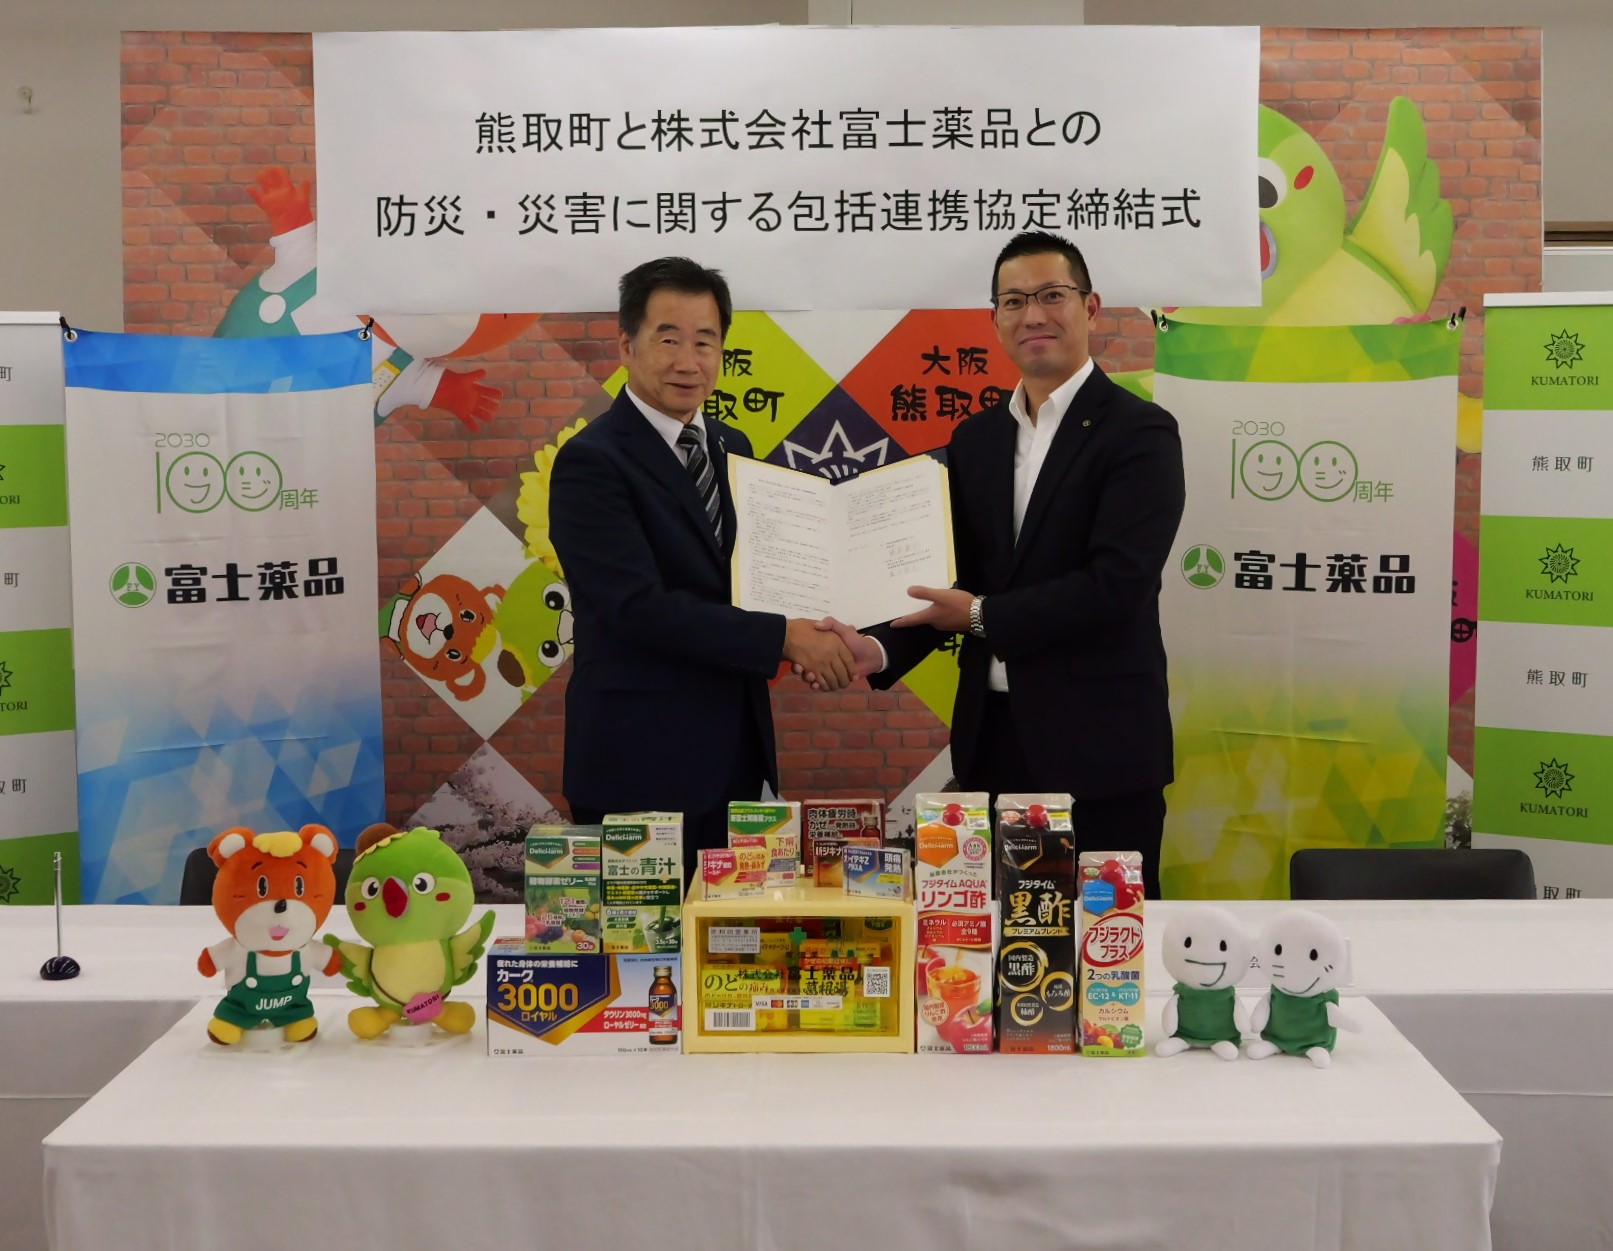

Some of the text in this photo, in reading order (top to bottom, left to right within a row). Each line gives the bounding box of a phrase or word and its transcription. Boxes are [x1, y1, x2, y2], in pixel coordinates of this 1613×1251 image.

[474, 107, 1101, 153] 熊取町と株式会社富士薬品との
[375, 187, 1202, 237] 防災・災害に関する包括連携協定締結式
[921, 345, 988, 375] 大阪
[1531, 376, 1599, 386] KUMATORI
[1232, 420, 1285, 436] 2030
[155, 433, 210, 448] 2030
[1532, 455, 1593, 472] 熊取町
[1234, 550, 1415, 593] 富士薬品
[165, 557, 344, 604] 富士薬品
[1525, 588, 1594, 602] KUMATORI
[1526, 668, 1588, 688] 熊取町
[1520, 802, 1588, 818] KUMATORI
[607, 857, 676, 876] 富士の青汁
[1018, 880, 1055, 890] フジタイム
[922, 890, 987, 909] リンゴ酢
[1004, 891, 1071, 927] 黒酢
[1089, 926, 1140, 944] フジラクト
[1101, 944, 1128, 959] プラス
[496, 968, 533, 983] カーク
[1007, 962, 1035, 976] 黒酢
[255, 995, 292, 1010] JUMP
[497, 983, 579, 1012] 3000
[521, 1011, 557, 1022] ロイヤル
